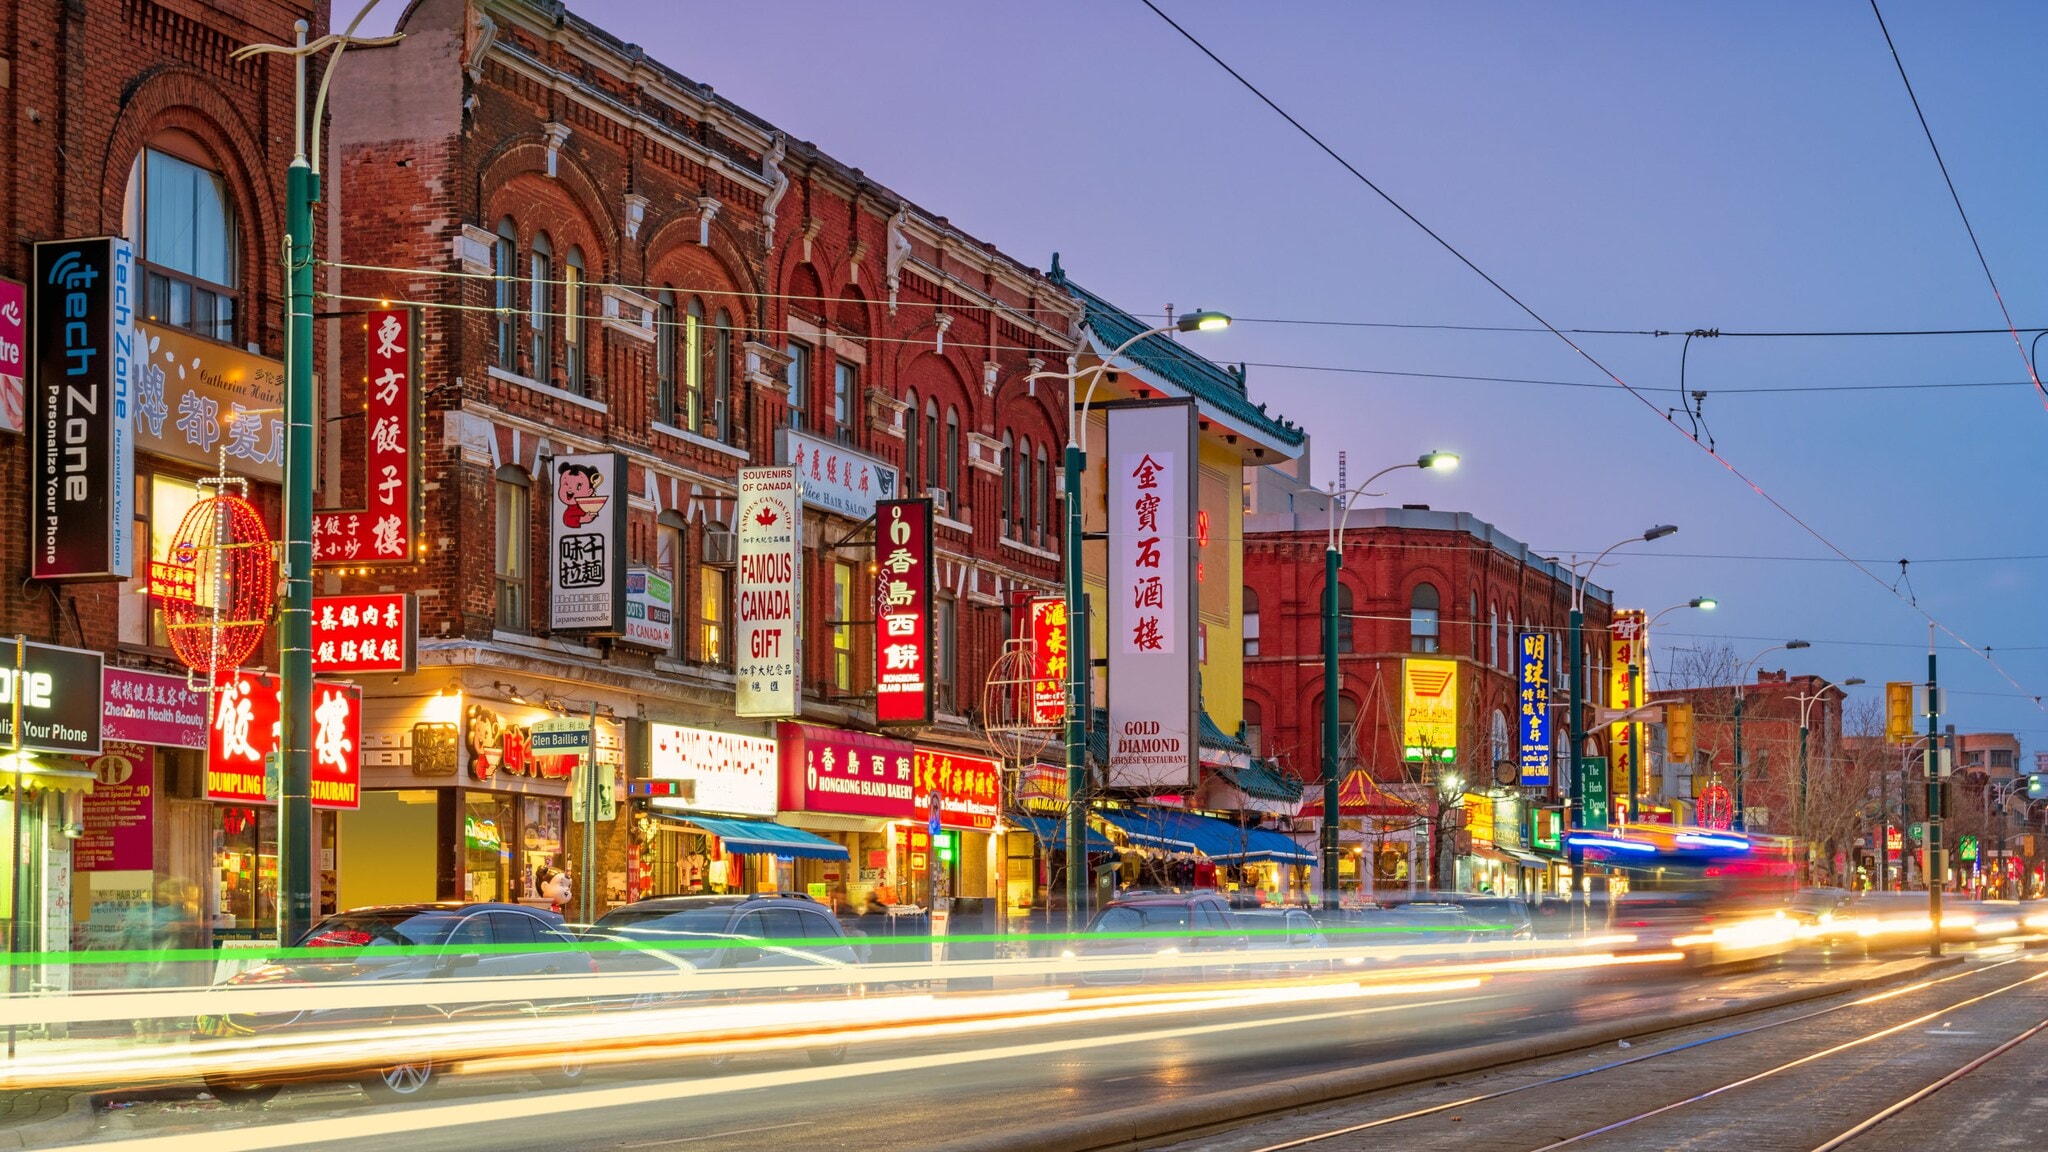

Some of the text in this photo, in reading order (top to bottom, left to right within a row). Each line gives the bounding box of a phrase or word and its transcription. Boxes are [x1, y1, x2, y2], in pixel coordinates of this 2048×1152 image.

[116, 246, 132, 419] tech Zone
[66, 264, 98, 501] tech Zone
[200, 368, 247, 396] Catherine
[251, 383, 274, 403] Hair
[372, 315, 407, 556] 東方餃子樓
[47, 385, 60, 564] Personalize Your Phone
[743, 470, 792, 480] SOUVENIRS
[743, 482, 792, 492] OF CANADA
[742, 496, 792, 532] FAMOUS CANADA GIFT
[823, 492, 842, 509] HAIR
[845, 499, 868, 516] SALON
[1132, 454, 1164, 652] 金寶石酒樓
[741, 552, 792, 585] FAMOUS
[627, 601, 643, 618] OOTS
[741, 590, 791, 621] CANADA
[884, 548, 919, 669] 香島西餅
[555, 613, 609, 625] japanese noodle
[636, 625, 662, 642] CANADA
[751, 629, 782, 659] GIFT
[105, 701, 204, 730] ZhenZhen Health Beauty
[215, 680, 352, 774] 餃樓
[23, 720, 51, 738] Your
[52, 724, 88, 742] Phone
[1125, 721, 1160, 735] GOLD
[532, 733, 588, 747] Glen Baillie Pl
[1119, 739, 1180, 754] DIAMOND
[821, 747, 911, 781] 香島西餅
[1111, 755, 1187, 765] CHINESE RESTAURANT
[1589, 764, 1599, 776] The
[208, 771, 260, 795] DUMPLING
[311, 781, 355, 802] STAURANT
[819, 776, 913, 800] HONGKONG ISLAND BAKERY
[1589, 781, 1602, 793] Herb
[945, 796, 966, 812] Seafood
[1590, 798, 1606, 811] Depot
[860, 870, 876, 880] ALICE
[117, 889, 131, 900] HAIR
